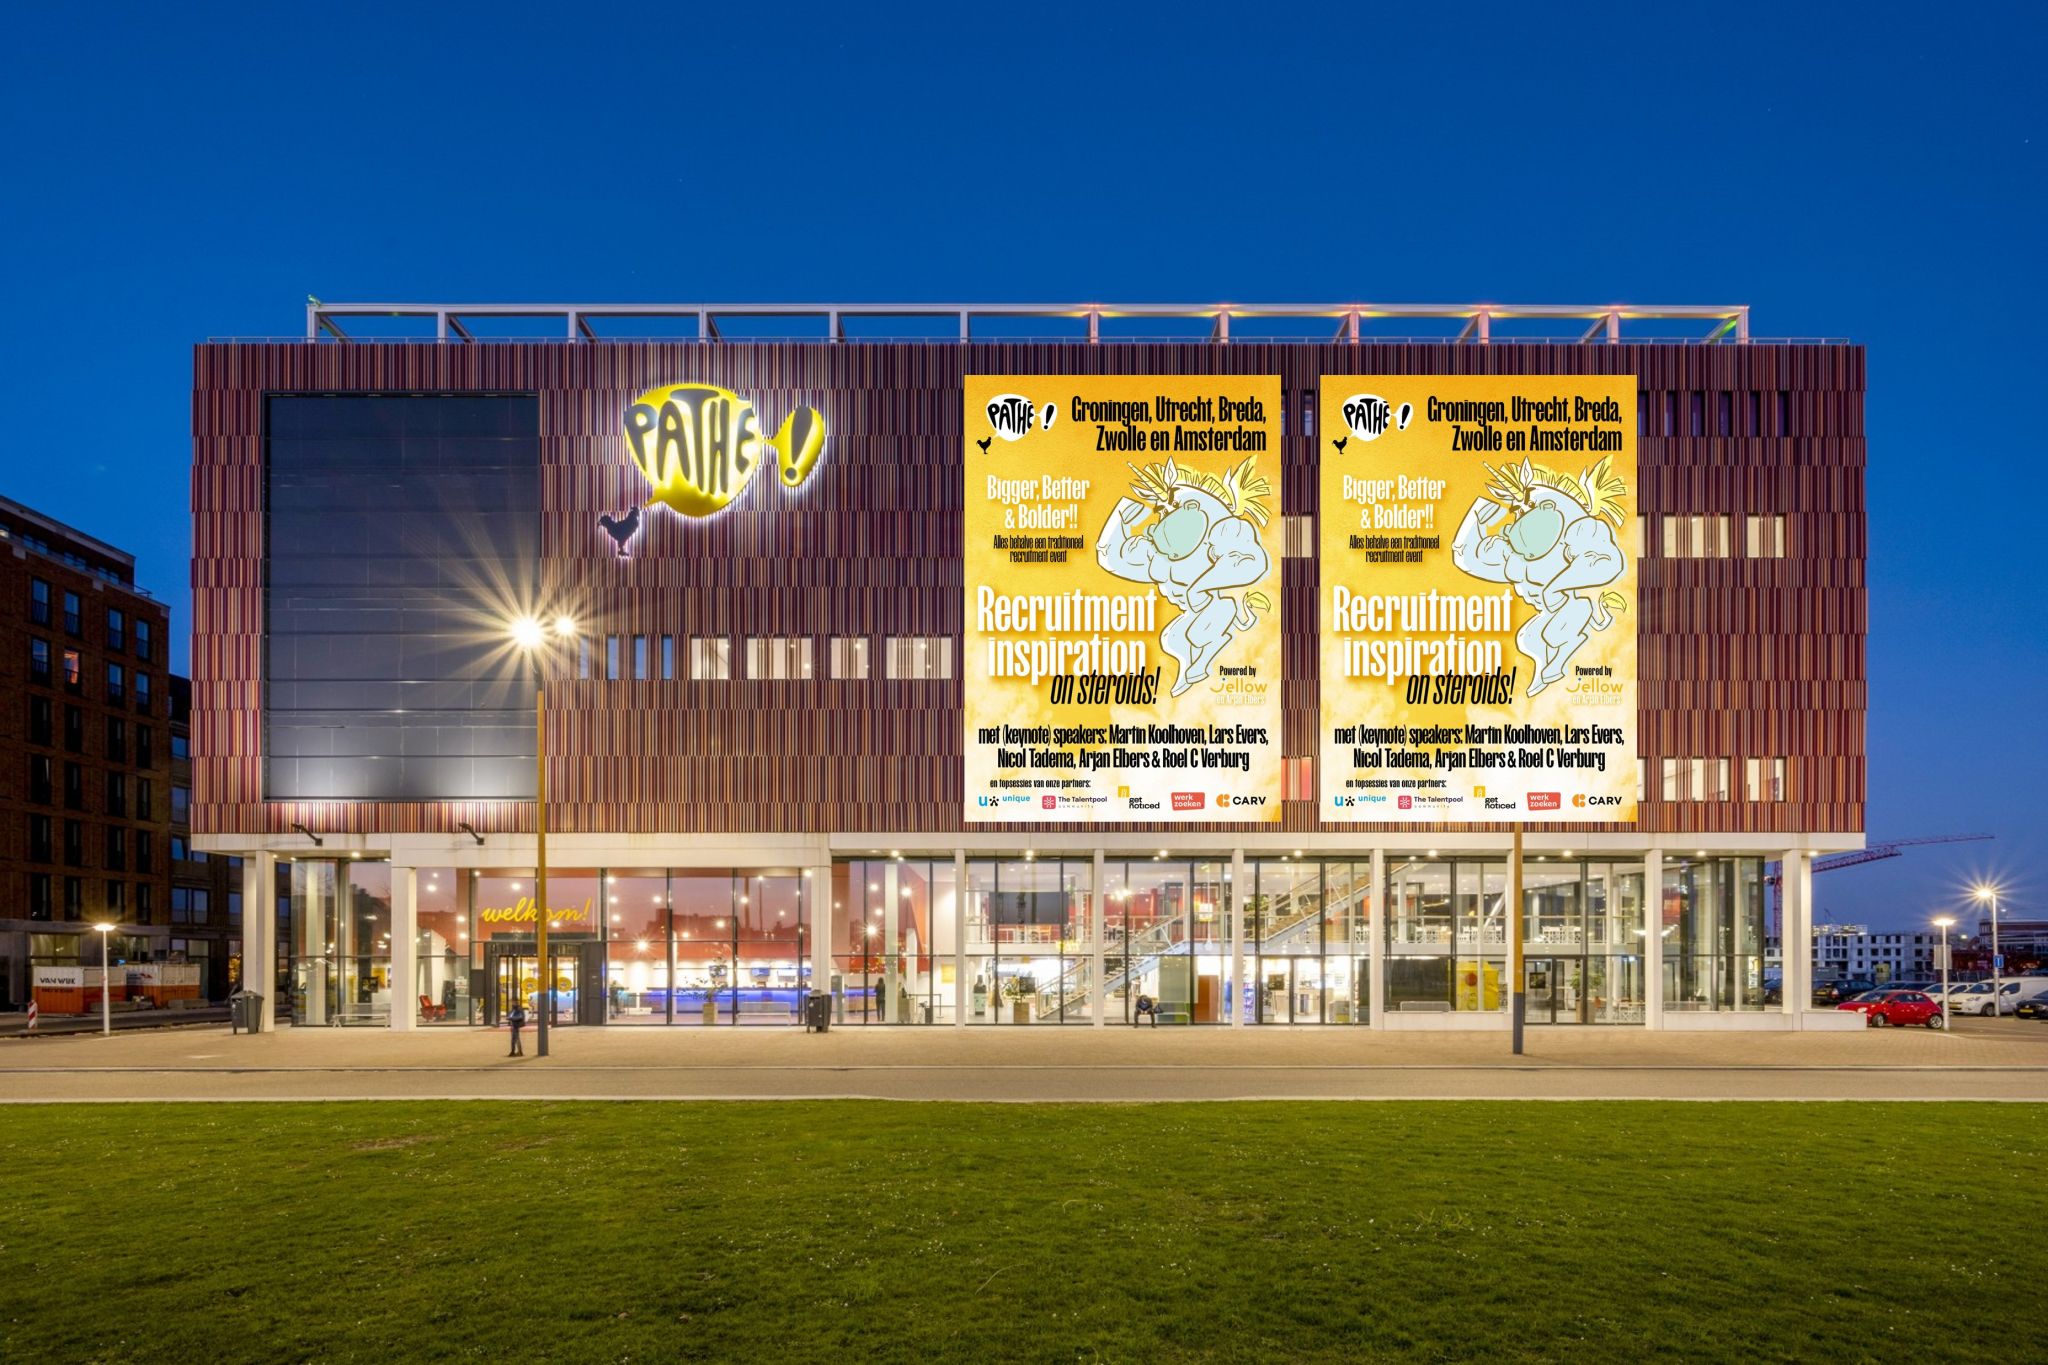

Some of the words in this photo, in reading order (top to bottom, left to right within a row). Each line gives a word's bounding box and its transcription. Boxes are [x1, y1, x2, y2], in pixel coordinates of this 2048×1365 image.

[1072, 395, 1152, 427] Groningen,
[1155, 396, 1215, 424] Utrecht,
[1218, 396, 1266, 424] Breda,
[1428, 395, 1508, 427] Groningen,
[1511, 396, 1571, 424] Utrecht,
[1574, 396, 1622, 424] Breda,
[1096, 425, 1146, 451] Zwolle
[1150, 430, 1170, 451] en
[1174, 425, 1266, 451] Amsterdam
[1452, 425, 1502, 451] Zwolle
[1506, 430, 1526, 451] en
[1530, 425, 1622, 451] Amsterdam
[987, 474, 1040, 504] Bigger,
[1042, 474, 1090, 500] Better
[1343, 474, 1396, 504] Bigger,
[1398, 474, 1446, 500] Better
[1004, 508, 1015, 529] &
[1018, 503, 1078, 529] Bolder!!
[1360, 508, 1371, 529] &
[1374, 503, 1434, 529] Bolder!!
[993, 534, 1009, 549] Alles
[1009, 534, 1033, 549] behalve
[1034, 537, 1046, 549] een
[1047, 534, 1084, 549] traditioneel
[1349, 534, 1365, 549] Alles
[1365, 534, 1389, 549] behalve
[1390, 537, 1402, 549] een
[1403, 534, 1440, 549] traditioneel
[1009, 550, 1049, 563] recruitment
[1049, 550, 1067, 563] event
[1365, 550, 1405, 563] recruitment
[1405, 550, 1423, 563] event
[977, 585, 1157, 632] Recruitment
[1333, 585, 1513, 632] Recruitment
[988, 633, 1146, 686] inspiration
[1219, 665, 1248, 676] Powered
[1248, 665, 1257, 677] by
[1344, 633, 1502, 686] inspiration
[1575, 665, 1604, 676] Powered
[1604, 665, 1613, 677] by
[1050, 674, 1074, 705] on
[1077, 666, 1161, 705] steroids!
[1406, 674, 1430, 705] on
[1433, 666, 1517, 705] steroids!
[978, 725, 1000, 744] met
[1002, 724, 1051, 747] (keynote)
[1053, 724, 1107, 747] speakers:
[1109, 724, 1146, 744] Martin
[1148, 724, 1207, 746] Koolhoven,
[1209, 724, 1234, 744] Lars
[1236, 724, 1269, 746] Evers,
[1334, 725, 1356, 744] met
[1358, 724, 1407, 747] (keynote)
[1409, 724, 1463, 747] speakers:
[1465, 724, 1502, 744] Martin
[1504, 724, 1563, 746] Koolhoven,
[1565, 724, 1590, 744] Lars
[1592, 724, 1625, 746] Evers,
[997, 748, 1026, 768] Nicol
[1029, 748, 1076, 770] Tadema,
[1079, 748, 1111, 771] Arjan
[1113, 748, 1150, 768] Elbers
[1151, 750, 1161, 768] &
[1162, 748, 1187, 768] Roel
[1190, 748, 1198, 768] C
[1201, 748, 1250, 772] Verburg
[1353, 748, 1382, 768] Nicol
[1385, 748, 1432, 770] Tadema,
[1435, 748, 1467, 771] Arjan
[1469, 748, 1506, 768] Elbers
[1507, 750, 1517, 768] &
[1518, 748, 1543, 768] Roel
[1546, 748, 1554, 768] C
[1557, 748, 1606, 772] Verburg
[989, 779, 998, 788] en
[999, 778, 1032, 789] topsessies
[1033, 779, 1044, 788] van
[1045, 779, 1060, 788] onze
[1345, 779, 1354, 788] en
[1355, 778, 1388, 789] topsessies
[1389, 779, 1400, 788] van
[1401, 779, 1416, 788] onze
[1002, 794, 1031, 802] unique
[1232, 796, 1266, 805] CARV
[1358, 794, 1387, 802] unique
[1588, 796, 1622, 805] CARV
